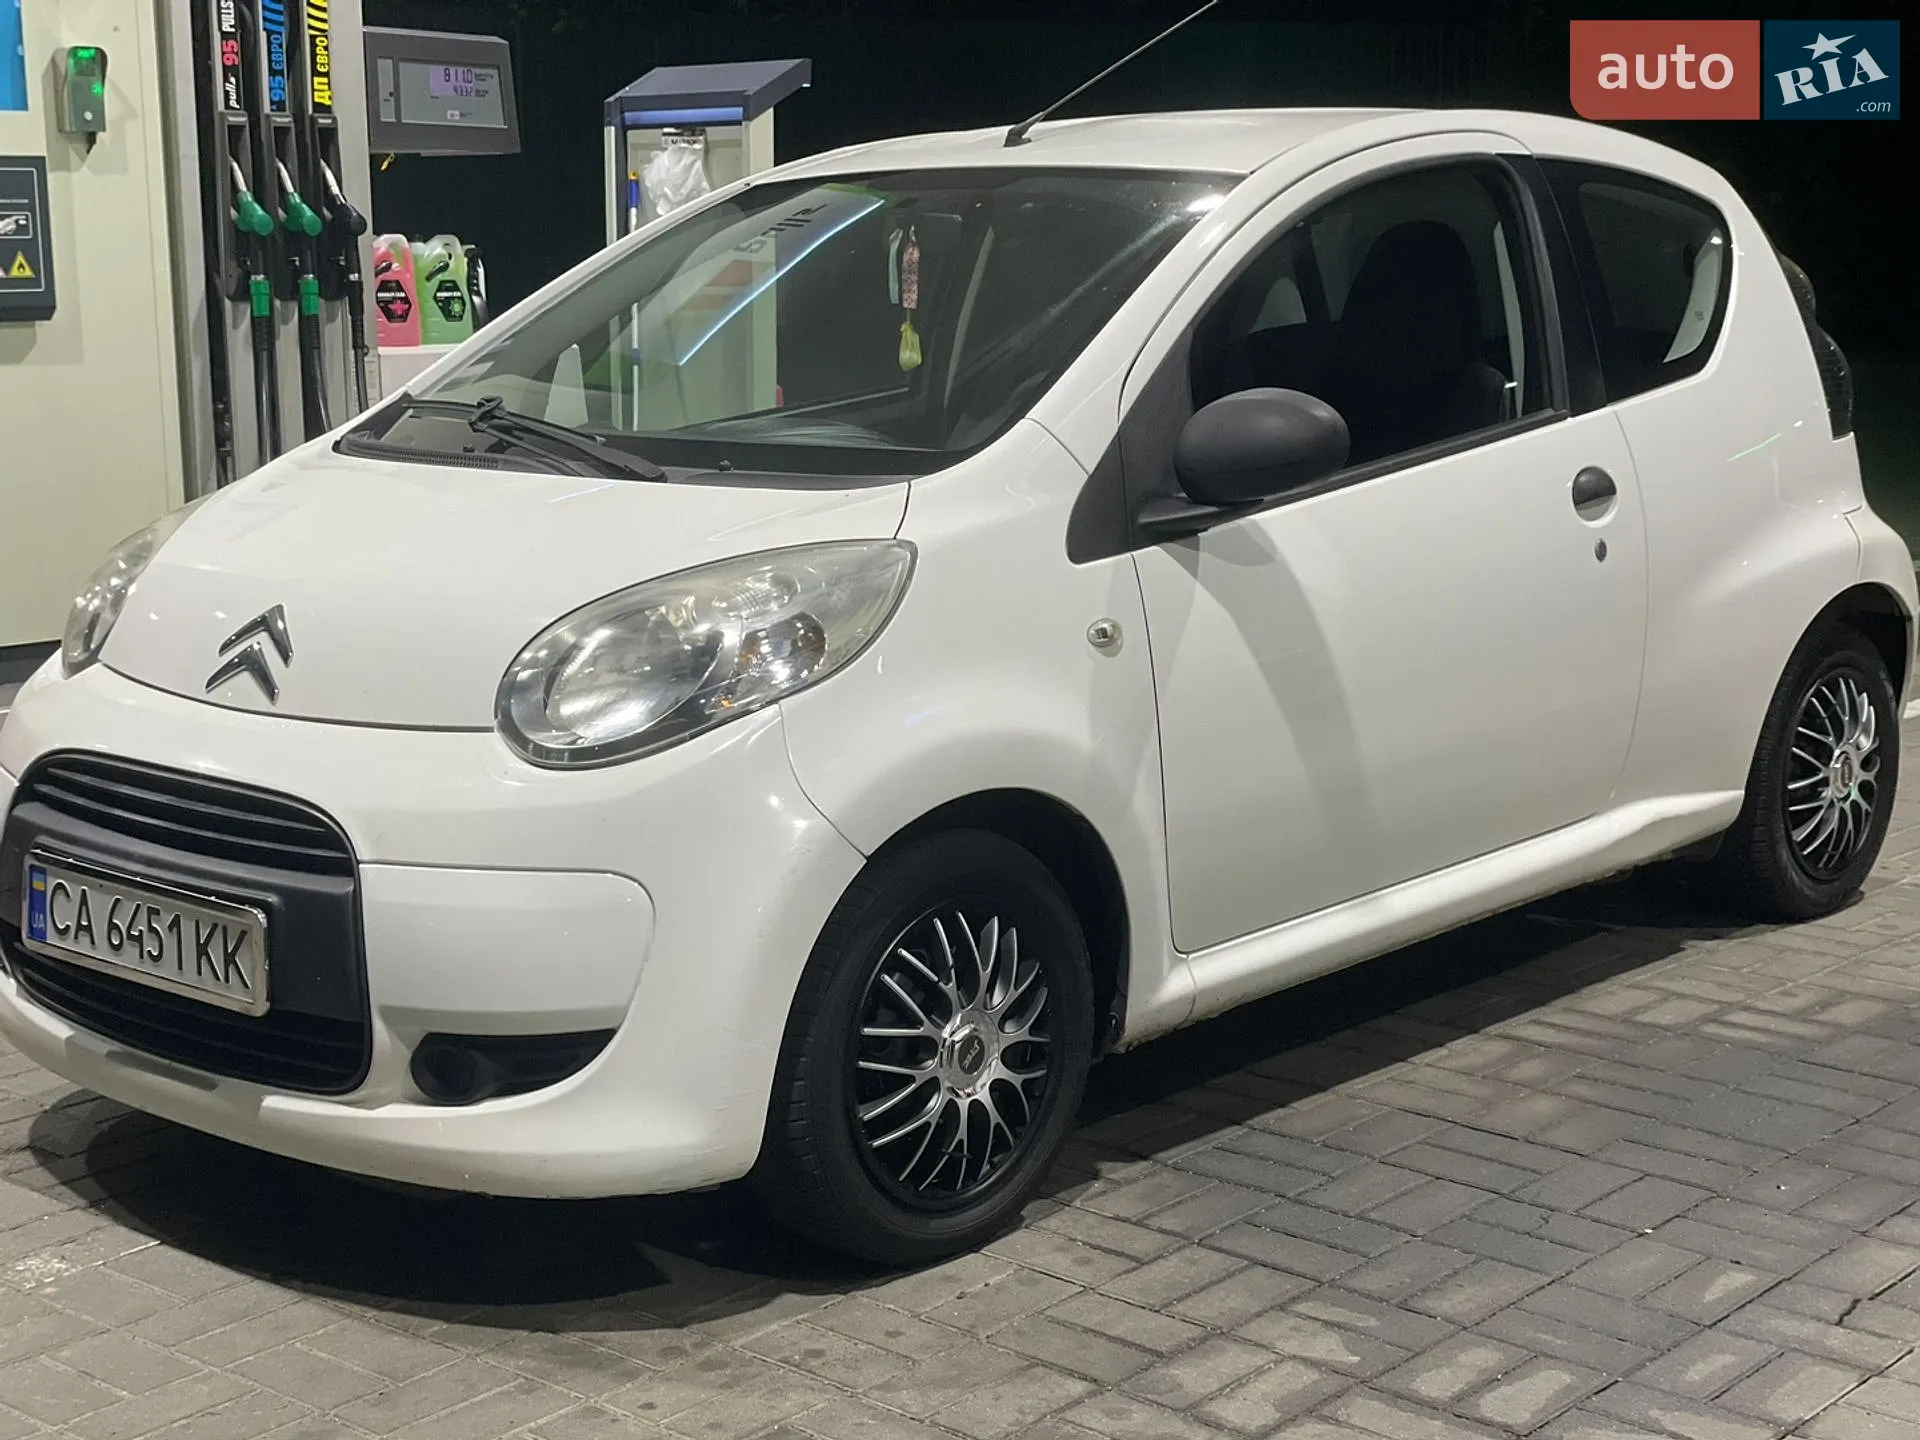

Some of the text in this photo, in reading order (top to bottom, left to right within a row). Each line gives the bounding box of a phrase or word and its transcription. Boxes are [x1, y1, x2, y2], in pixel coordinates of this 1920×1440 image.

[220, 0, 236, 32] PULLS
[222, 39, 239, 67] 95
[270, 75, 286, 102] 95
[313, 76, 332, 106] ДП
[31, 911, 46, 932] UA
[49, 879, 252, 990] CA 6451 KK
